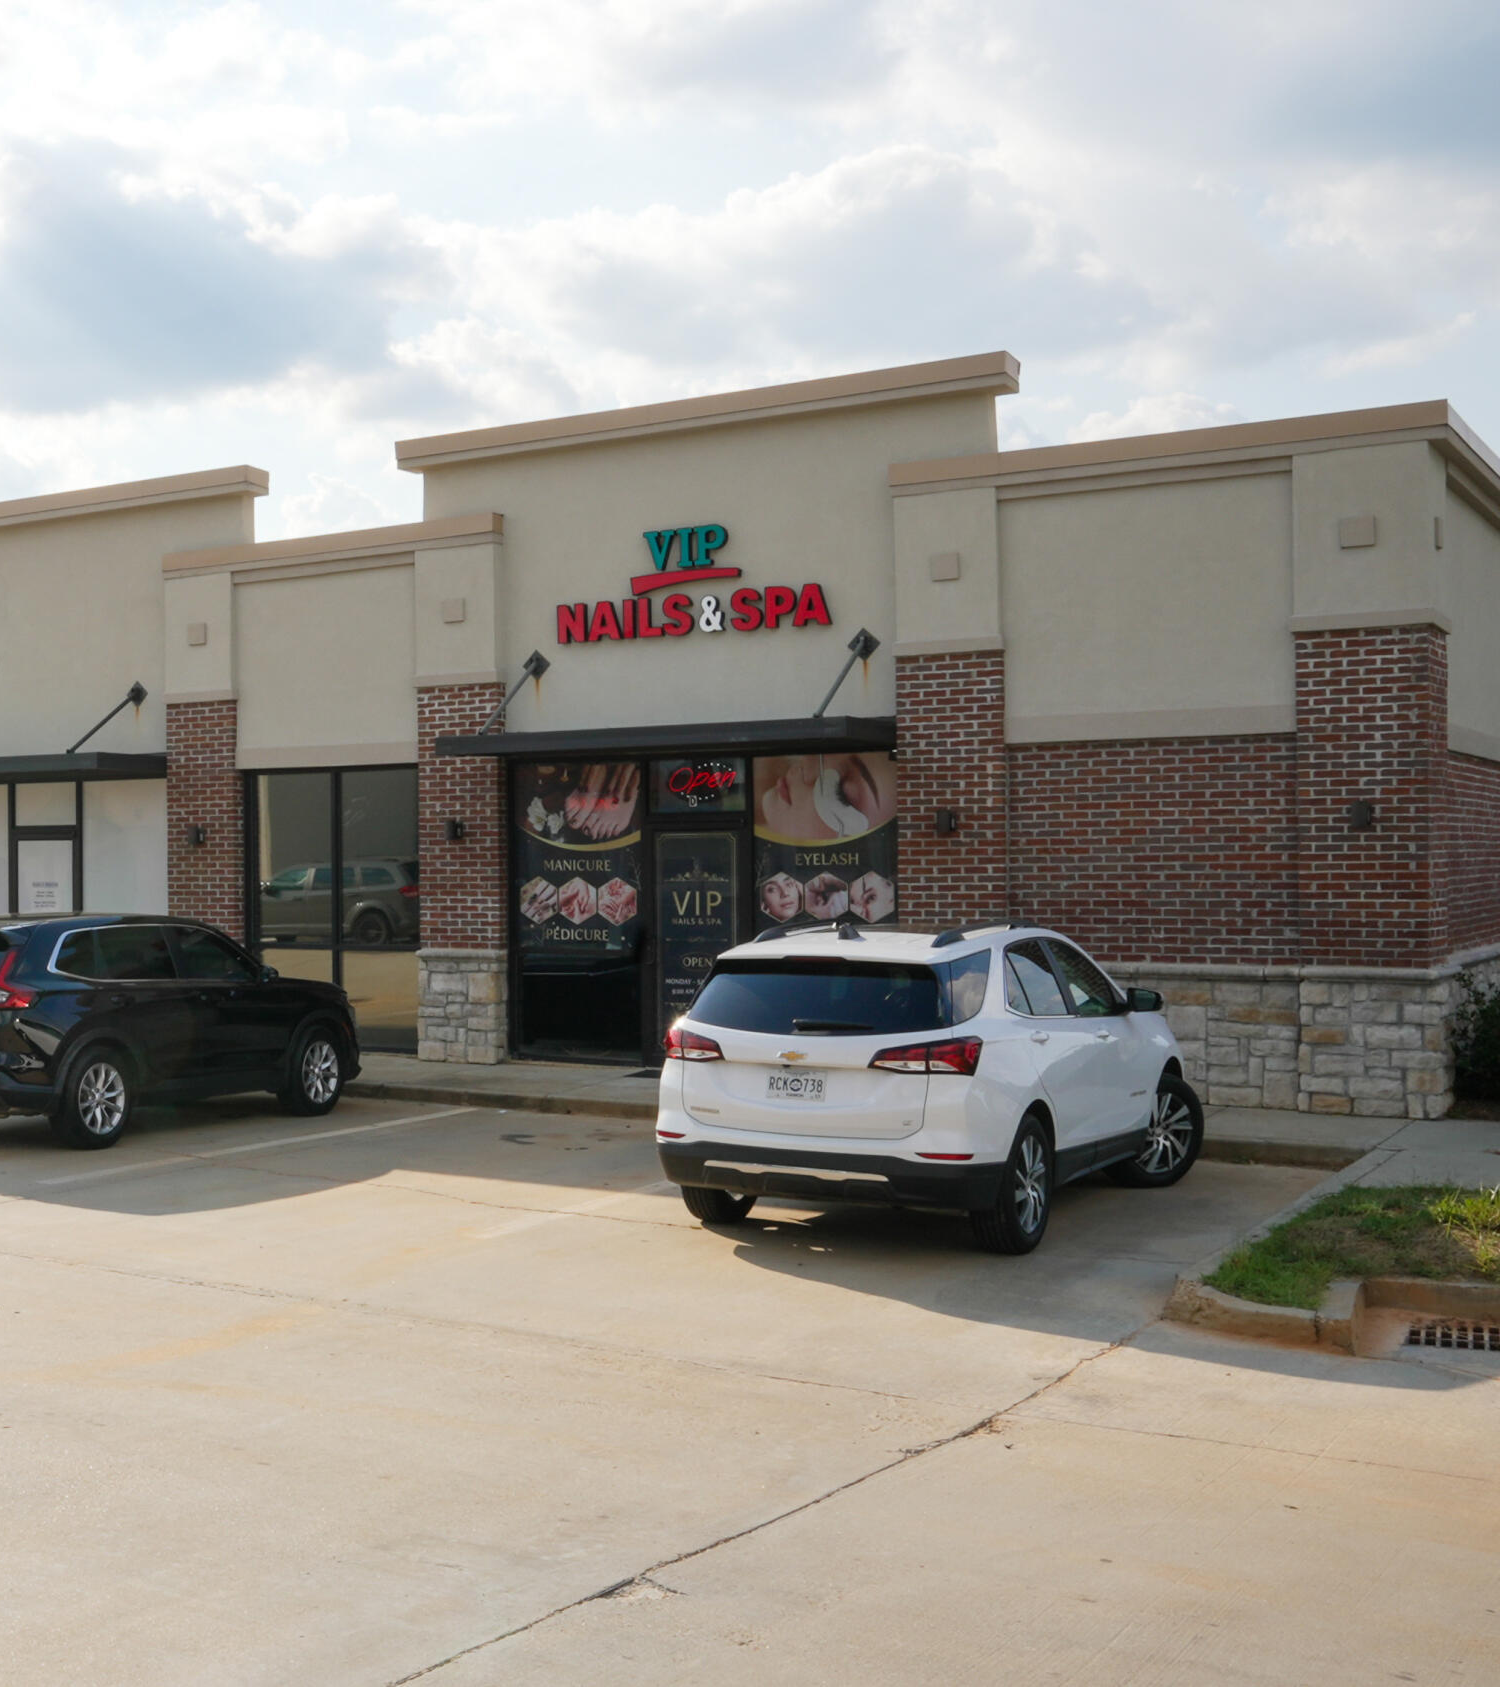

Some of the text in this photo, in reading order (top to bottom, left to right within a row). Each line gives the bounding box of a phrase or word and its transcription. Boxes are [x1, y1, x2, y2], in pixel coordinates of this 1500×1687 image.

[643, 524, 729, 570] VIP
[556, 583, 832, 645] NAILS & SPA
[668, 767, 737, 794] Open
[543, 859, 612, 872] MANICURE
[795, 852, 859, 866] EYELASH
[671, 890, 723, 916] VIP
[671, 917, 722, 926] NAILS & SPA
[546, 928, 609, 941] PEDICURE
[682, 957, 713, 968] OPEN
[769, 1076, 823, 1093] RCK 738
